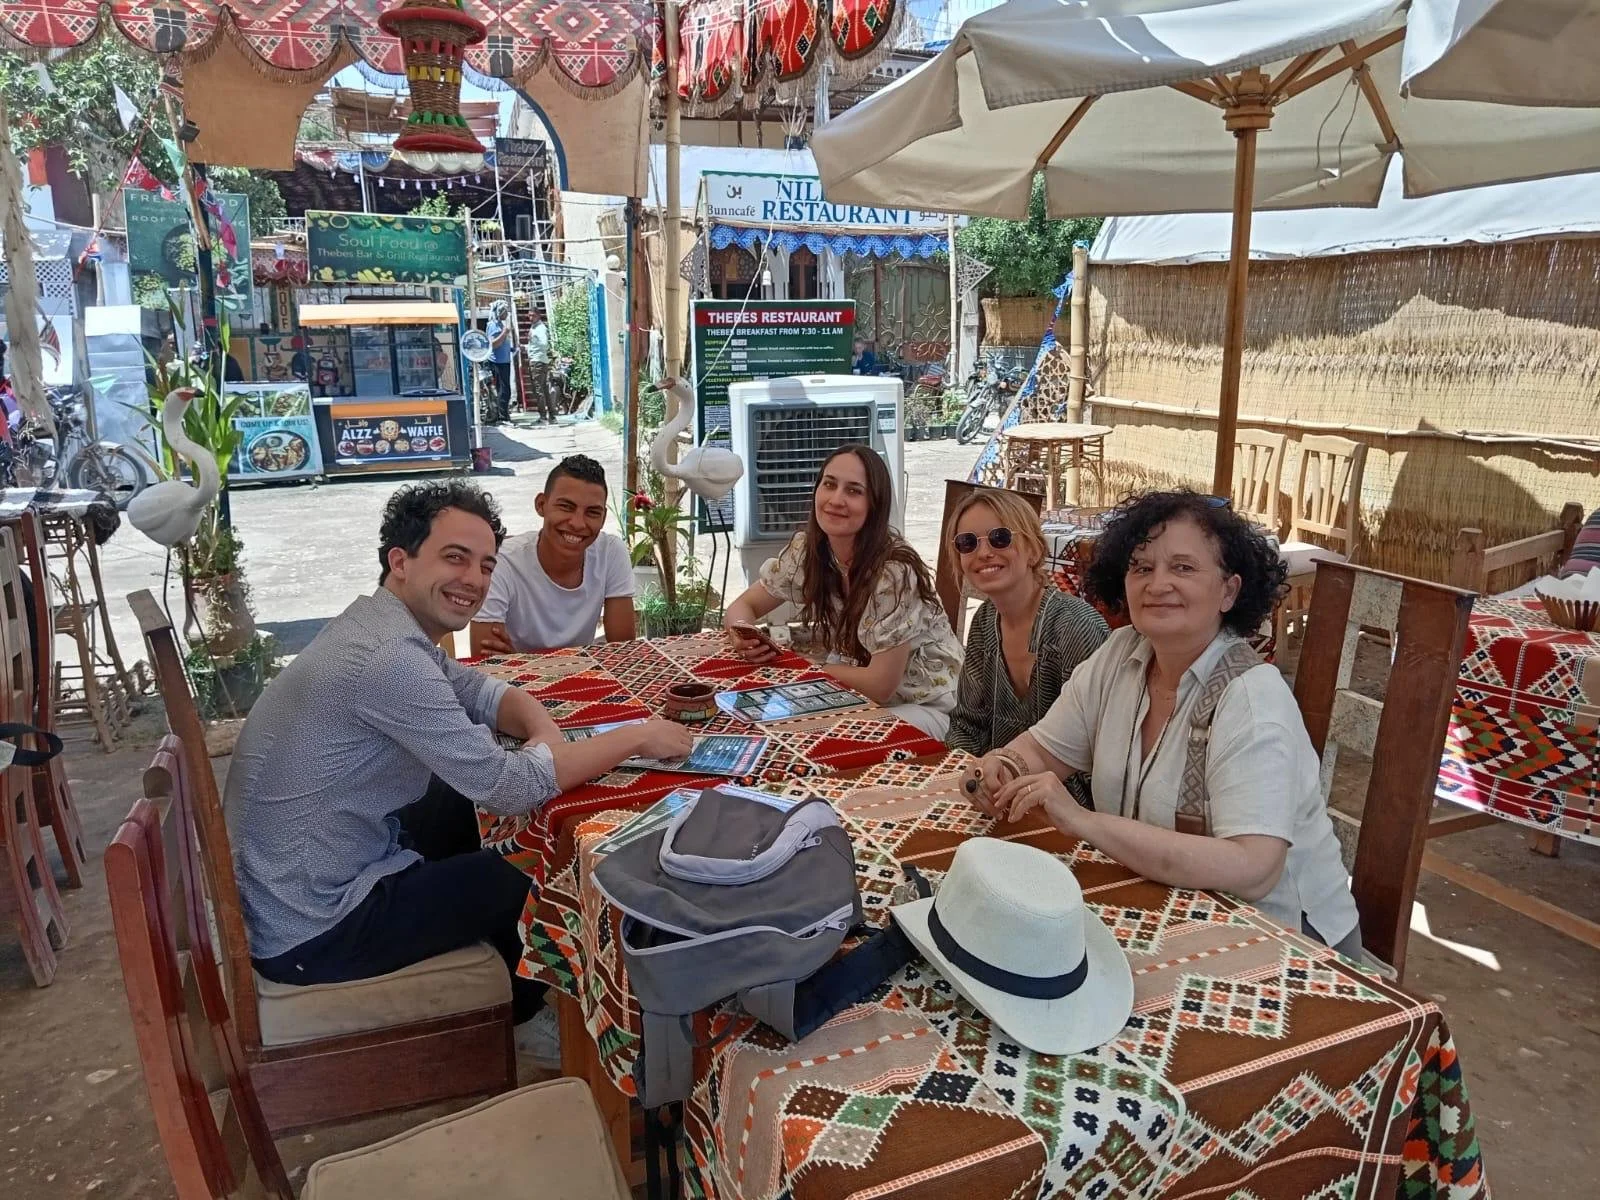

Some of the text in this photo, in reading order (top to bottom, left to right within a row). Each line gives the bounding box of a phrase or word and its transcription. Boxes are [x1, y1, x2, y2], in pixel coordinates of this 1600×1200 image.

[726, 184, 742, 199] بن
[776, 179, 825, 202] NIL
[707, 204, 756, 217] Bunncafé
[762, 200, 911, 225] RESTAURANT
[131, 215, 164, 223] ROOF
[338, 233, 375, 248] Soul
[379, 235, 420, 250] Food
[317, 247, 461, 263] Thebes Bar & Grill Restaurant
[707, 311, 843, 324] THEBES RESTAURANT
[736, 328, 778, 336] BREAKFAST
[801, 327, 816, 335] 7:30
[822, 327, 831, 335] 11
[832, 327, 844, 335] AM
[341, 425, 444, 440] ALZZ WAFFLE
